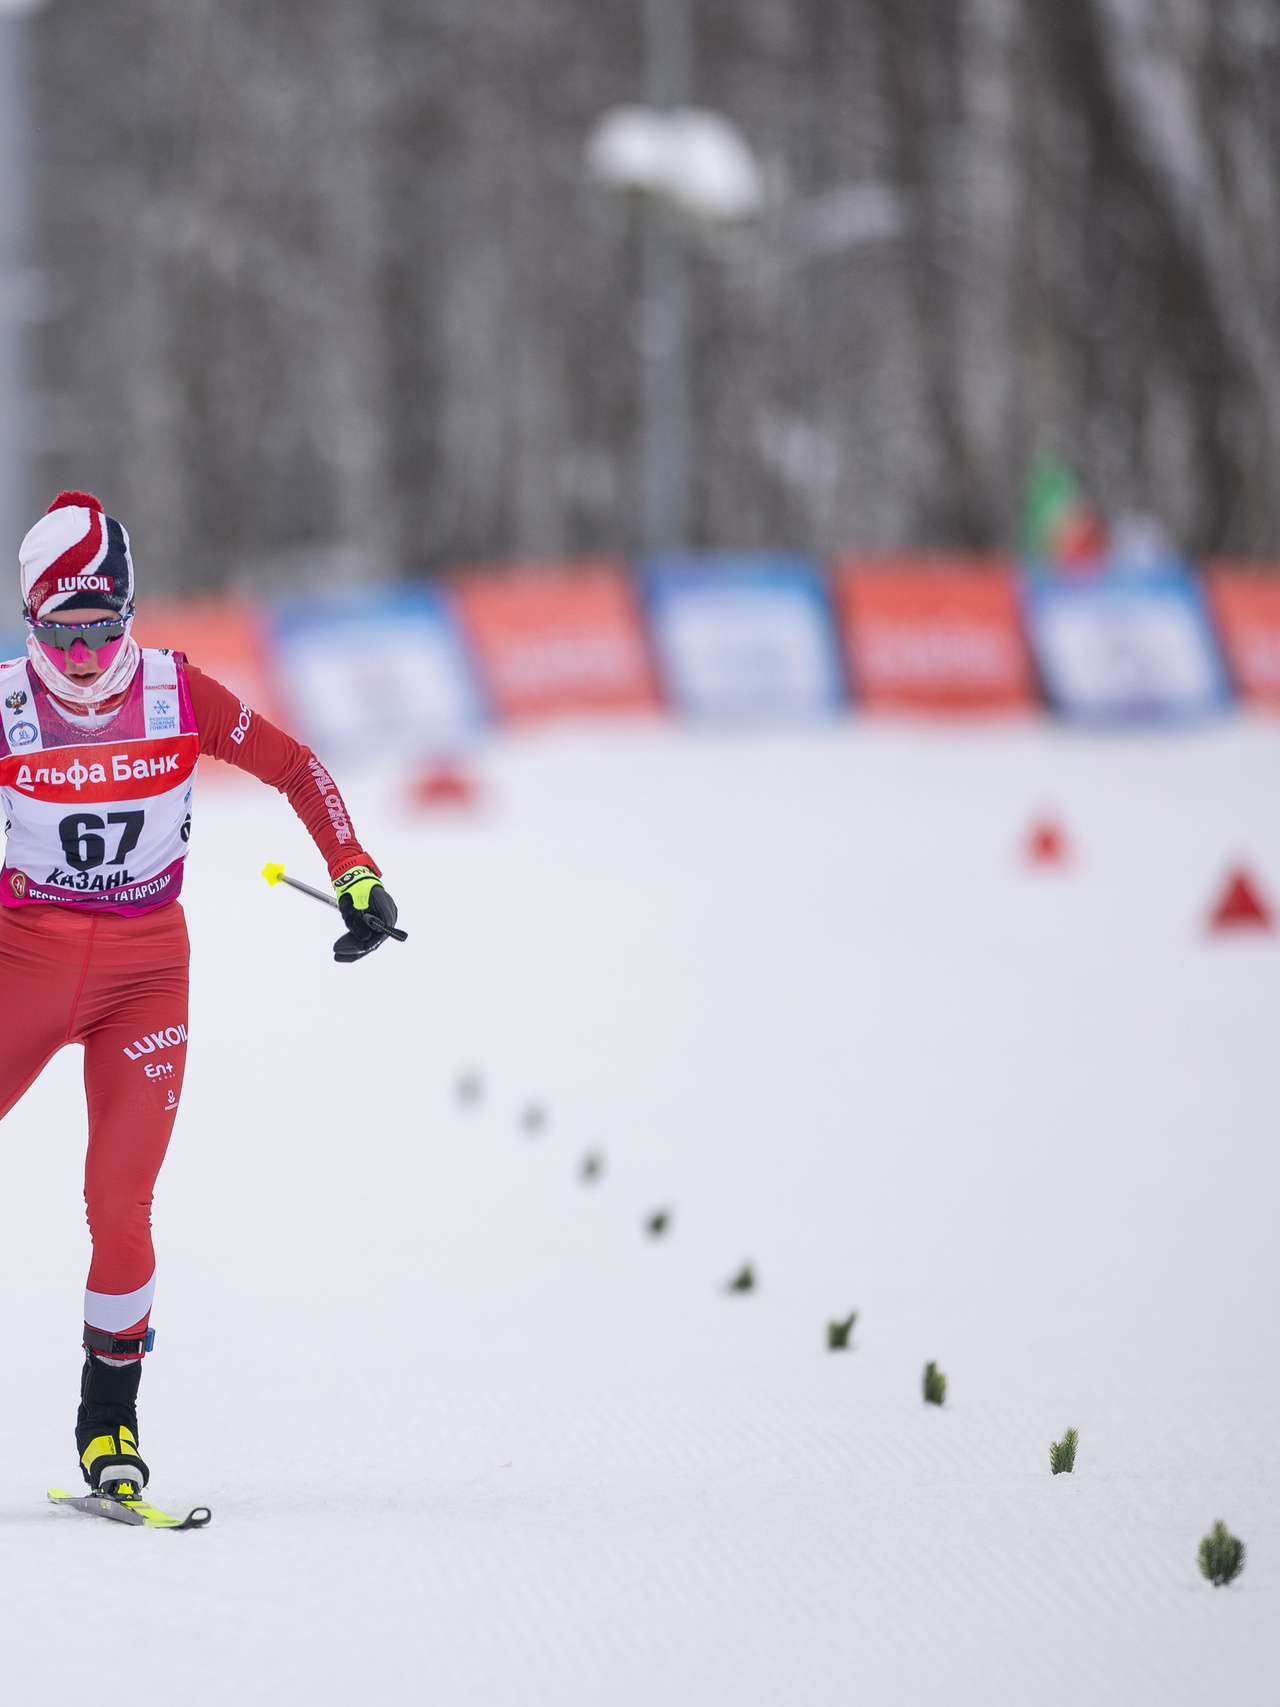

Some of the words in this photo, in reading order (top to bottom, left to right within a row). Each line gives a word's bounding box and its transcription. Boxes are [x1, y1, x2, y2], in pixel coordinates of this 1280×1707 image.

[57, 575, 111, 592] LUKOIL
[16, 758, 107, 792] Альфа
[111, 753, 180, 782] Банк
[58, 809, 145, 872] 67
[45, 867, 135, 891] КАЗАНЬ
[123, 1023, 188, 1061] LUKOIL
